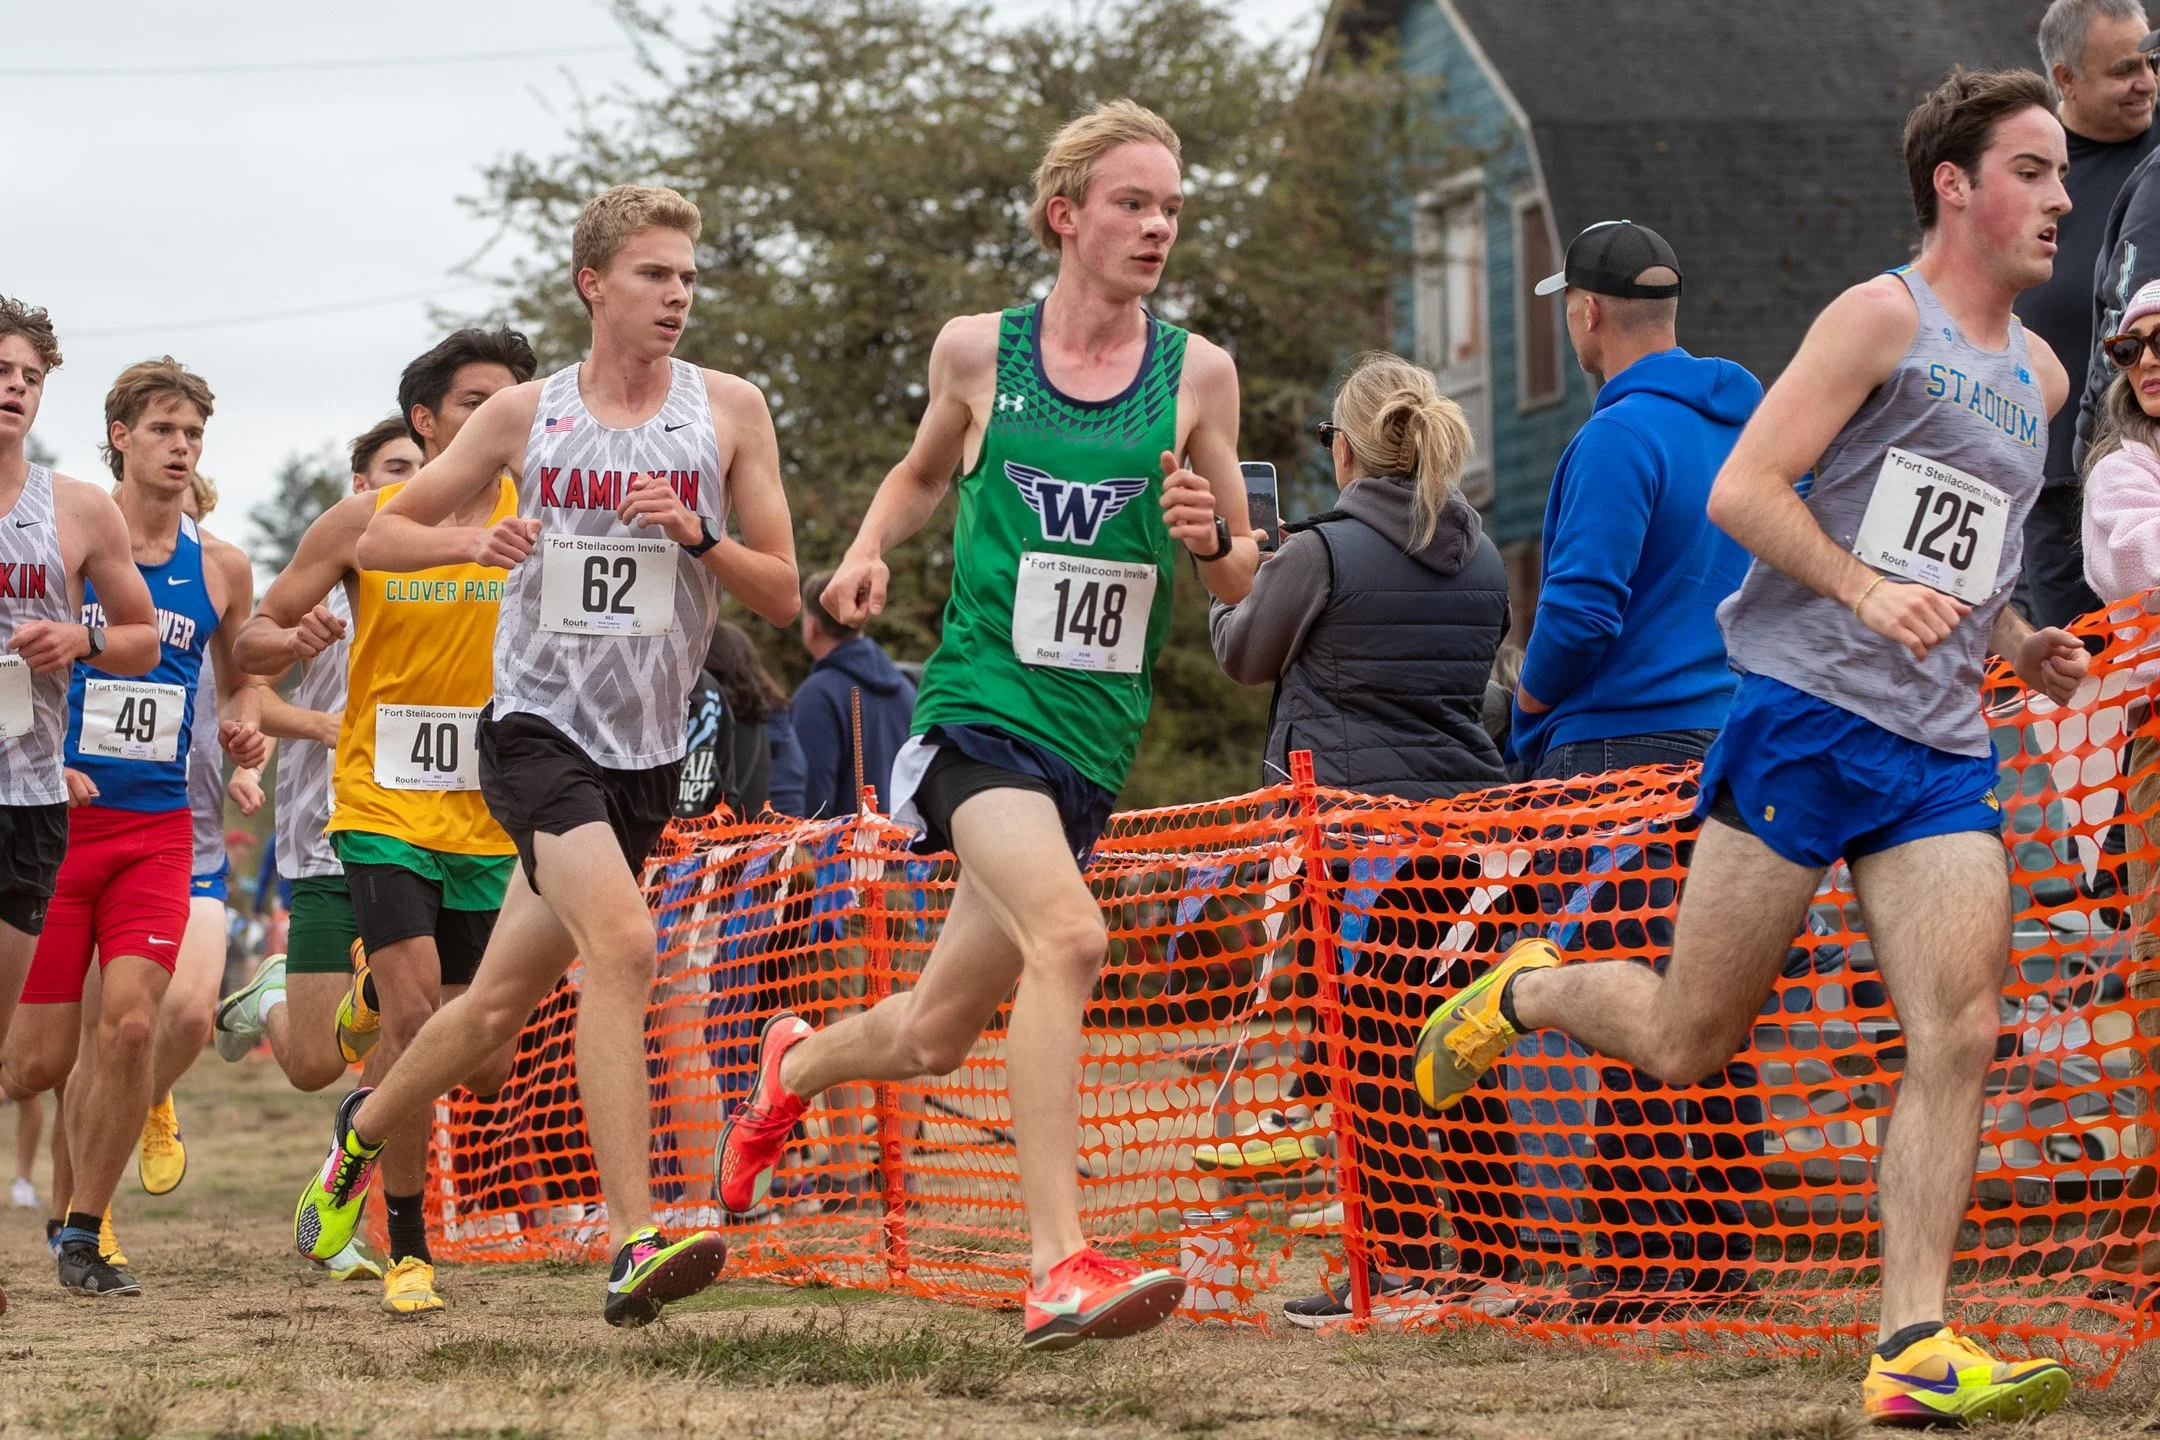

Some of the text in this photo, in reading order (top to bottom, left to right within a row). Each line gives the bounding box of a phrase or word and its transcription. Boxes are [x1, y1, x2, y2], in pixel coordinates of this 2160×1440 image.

[1926, 363, 2038, 449] STADIUM
[540, 466, 700, 511] KAMIIN
[1895, 456, 2002, 507] Fort Steilacoom Invite
[1032, 478, 1115, 545] W
[1902, 484, 1985, 571] 125
[552, 539, 666, 554] Fort Steilacoom Invite
[1031, 558, 1149, 580] Fort Steilacoom Invite
[1881, 551, 1908, 568] Rout
[386, 580, 458, 602] CLOVER
[582, 555, 637, 614] 62
[1053, 578, 1127, 648] 148
[93, 683, 178, 696] Fort Steilacoom Invite
[114, 697, 158, 744] 49
[384, 709, 481, 720] Fort Steilacoom Invit
[410, 722, 459, 773] 40
